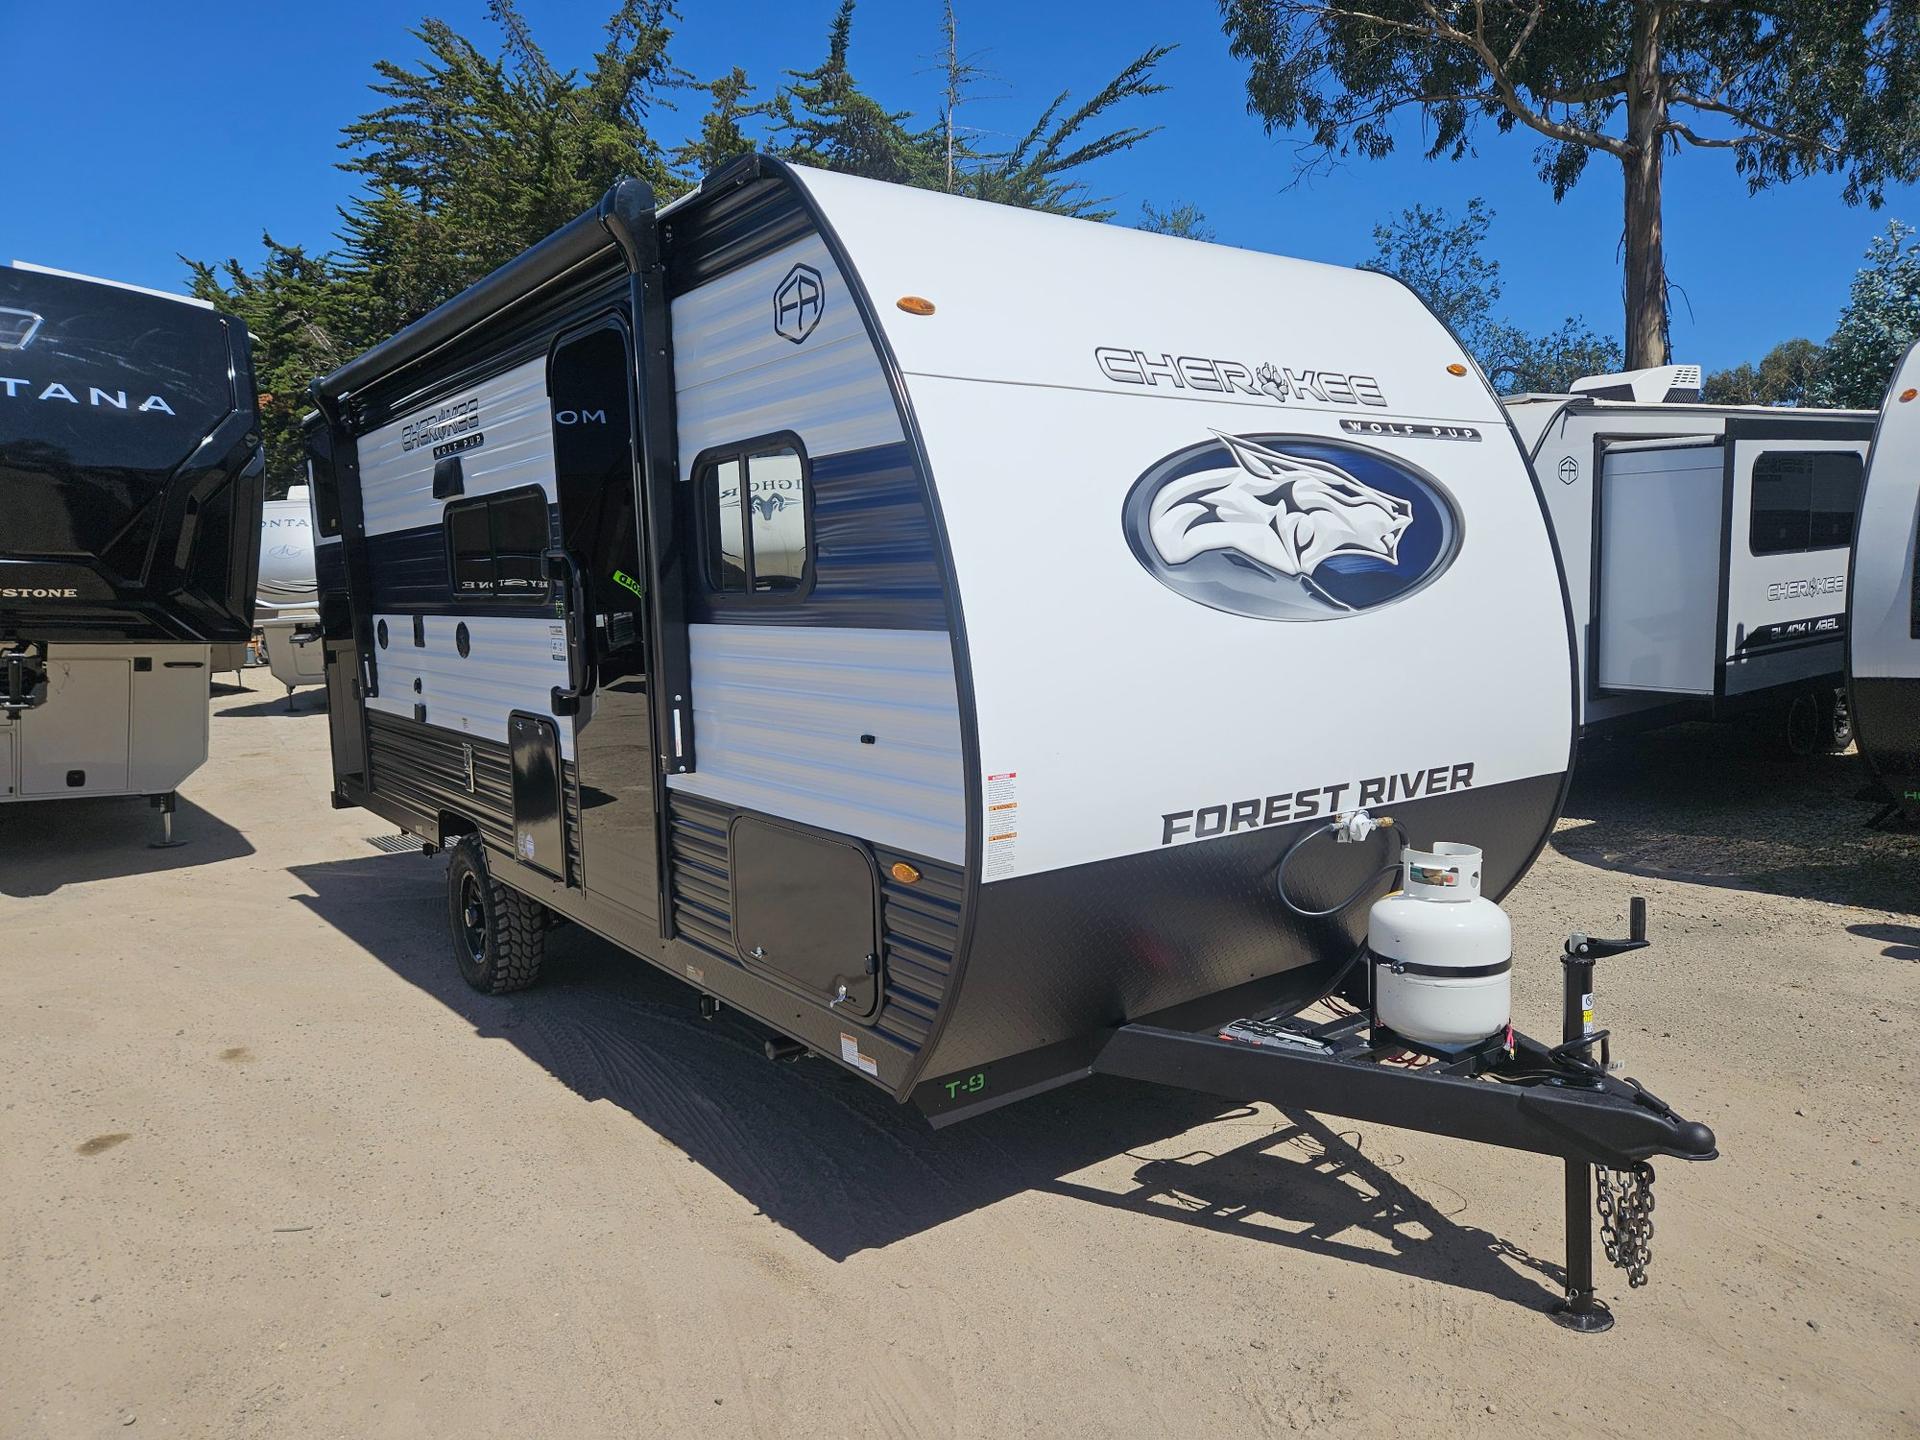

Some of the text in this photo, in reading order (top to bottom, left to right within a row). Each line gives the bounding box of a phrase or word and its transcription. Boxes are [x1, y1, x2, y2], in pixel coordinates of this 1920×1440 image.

[0, 376, 176, 416] TANA
[1348, 421, 1473, 439] WOLF PUP
[435, 434, 481, 454] WOLF PUP
[0, 587, 78, 598] STONE
[1771, 617, 1839, 640] BLACK LABEL
[1161, 761, 1475, 845] FOREST RIVER
